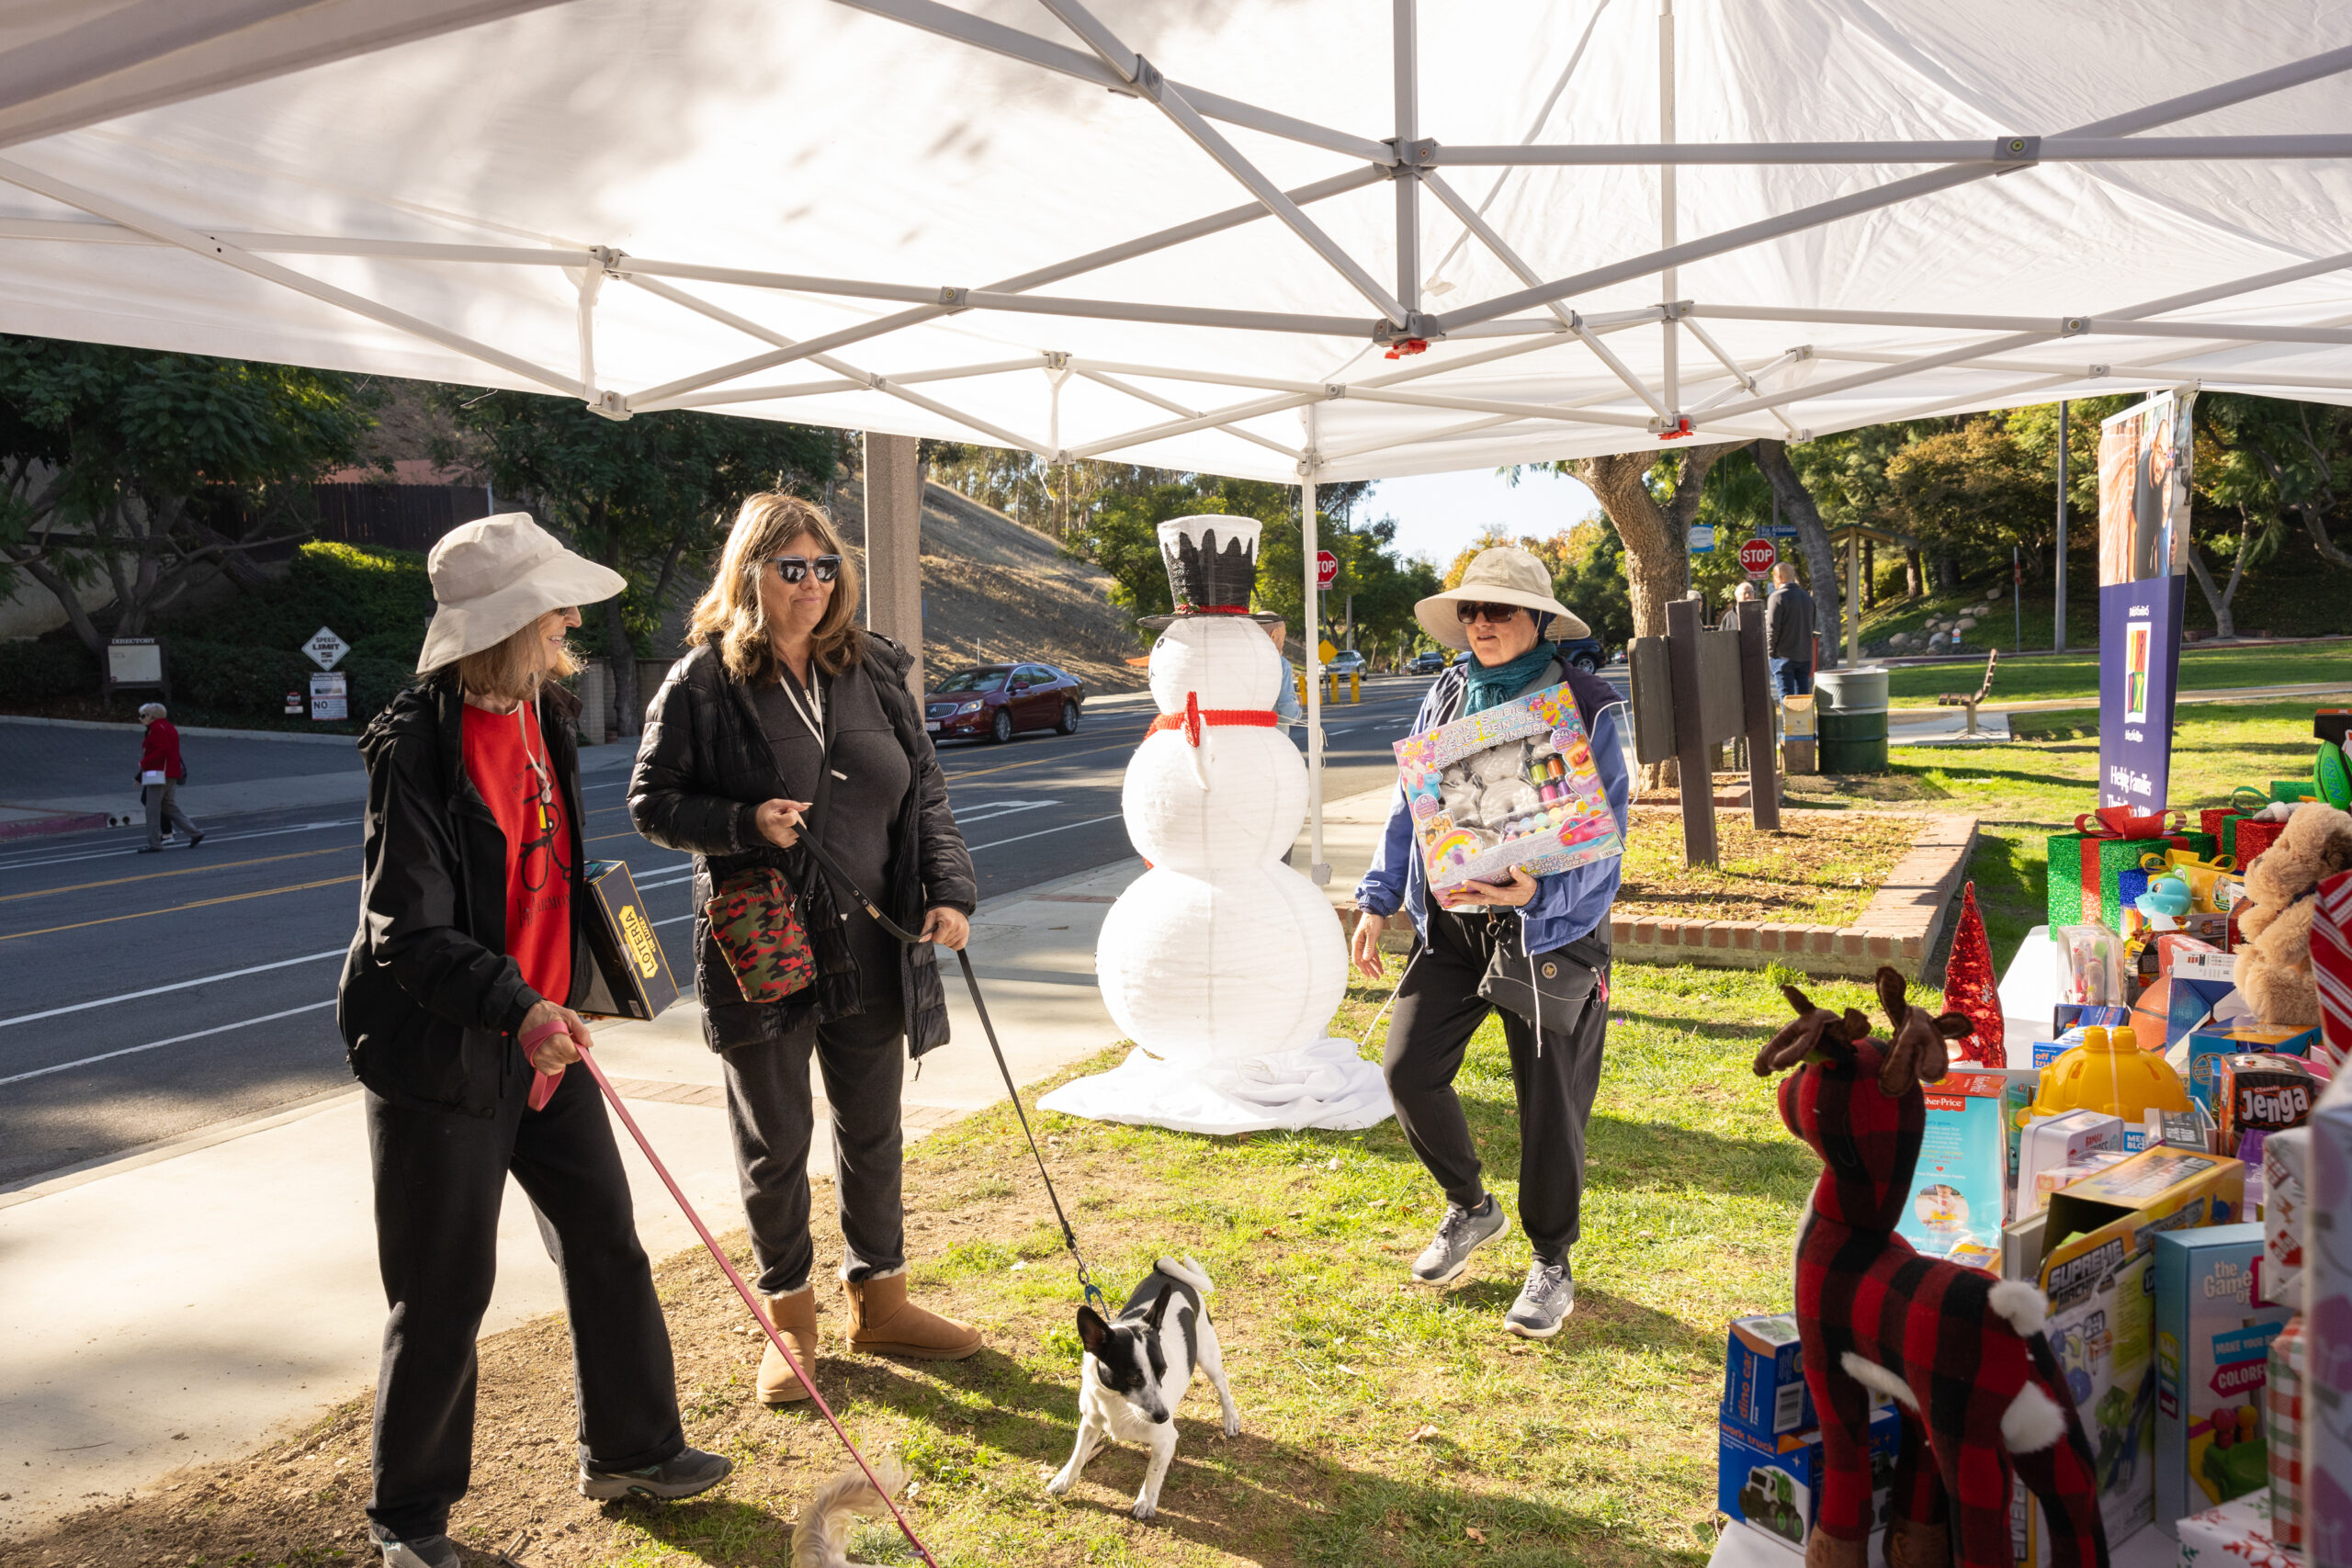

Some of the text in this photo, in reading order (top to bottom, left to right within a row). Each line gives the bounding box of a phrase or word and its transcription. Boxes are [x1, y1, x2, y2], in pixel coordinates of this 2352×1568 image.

[1317, 560, 1336, 573] TOP
[1742, 549, 1773, 563] STOP
[313, 701, 328, 709] NO
[1434, 728, 1482, 758] ATELIER
[1481, 710, 1544, 737] PEINTURE
[1442, 705, 1527, 740] PAINT STUDIO
[1555, 731, 1568, 741] 24
[1434, 739, 1484, 770] ESTUDIO
[1497, 723, 1552, 746] PINTURA
[2325, 757, 2345, 800] NERF
[1531, 852, 1568, 867] STUDIO
[625, 910, 655, 973] LOTERÍA
[2255, 1084, 2280, 1093] Classic
[2242, 1088, 2309, 1123] Jenga
[2049, 1237, 2125, 1294] SUPREME
[2214, 1260, 2238, 1279] the
[2204, 1269, 2254, 1300] Game
[2215, 1341, 2242, 1355] MAKE
[2244, 1337, 2266, 1350] YOUR
[1737, 1351, 1753, 1419] dino car
[2161, 1337, 2177, 1415] LIFE
[1721, 1423, 1746, 1442] work
[1747, 1434, 1776, 1455] truck
